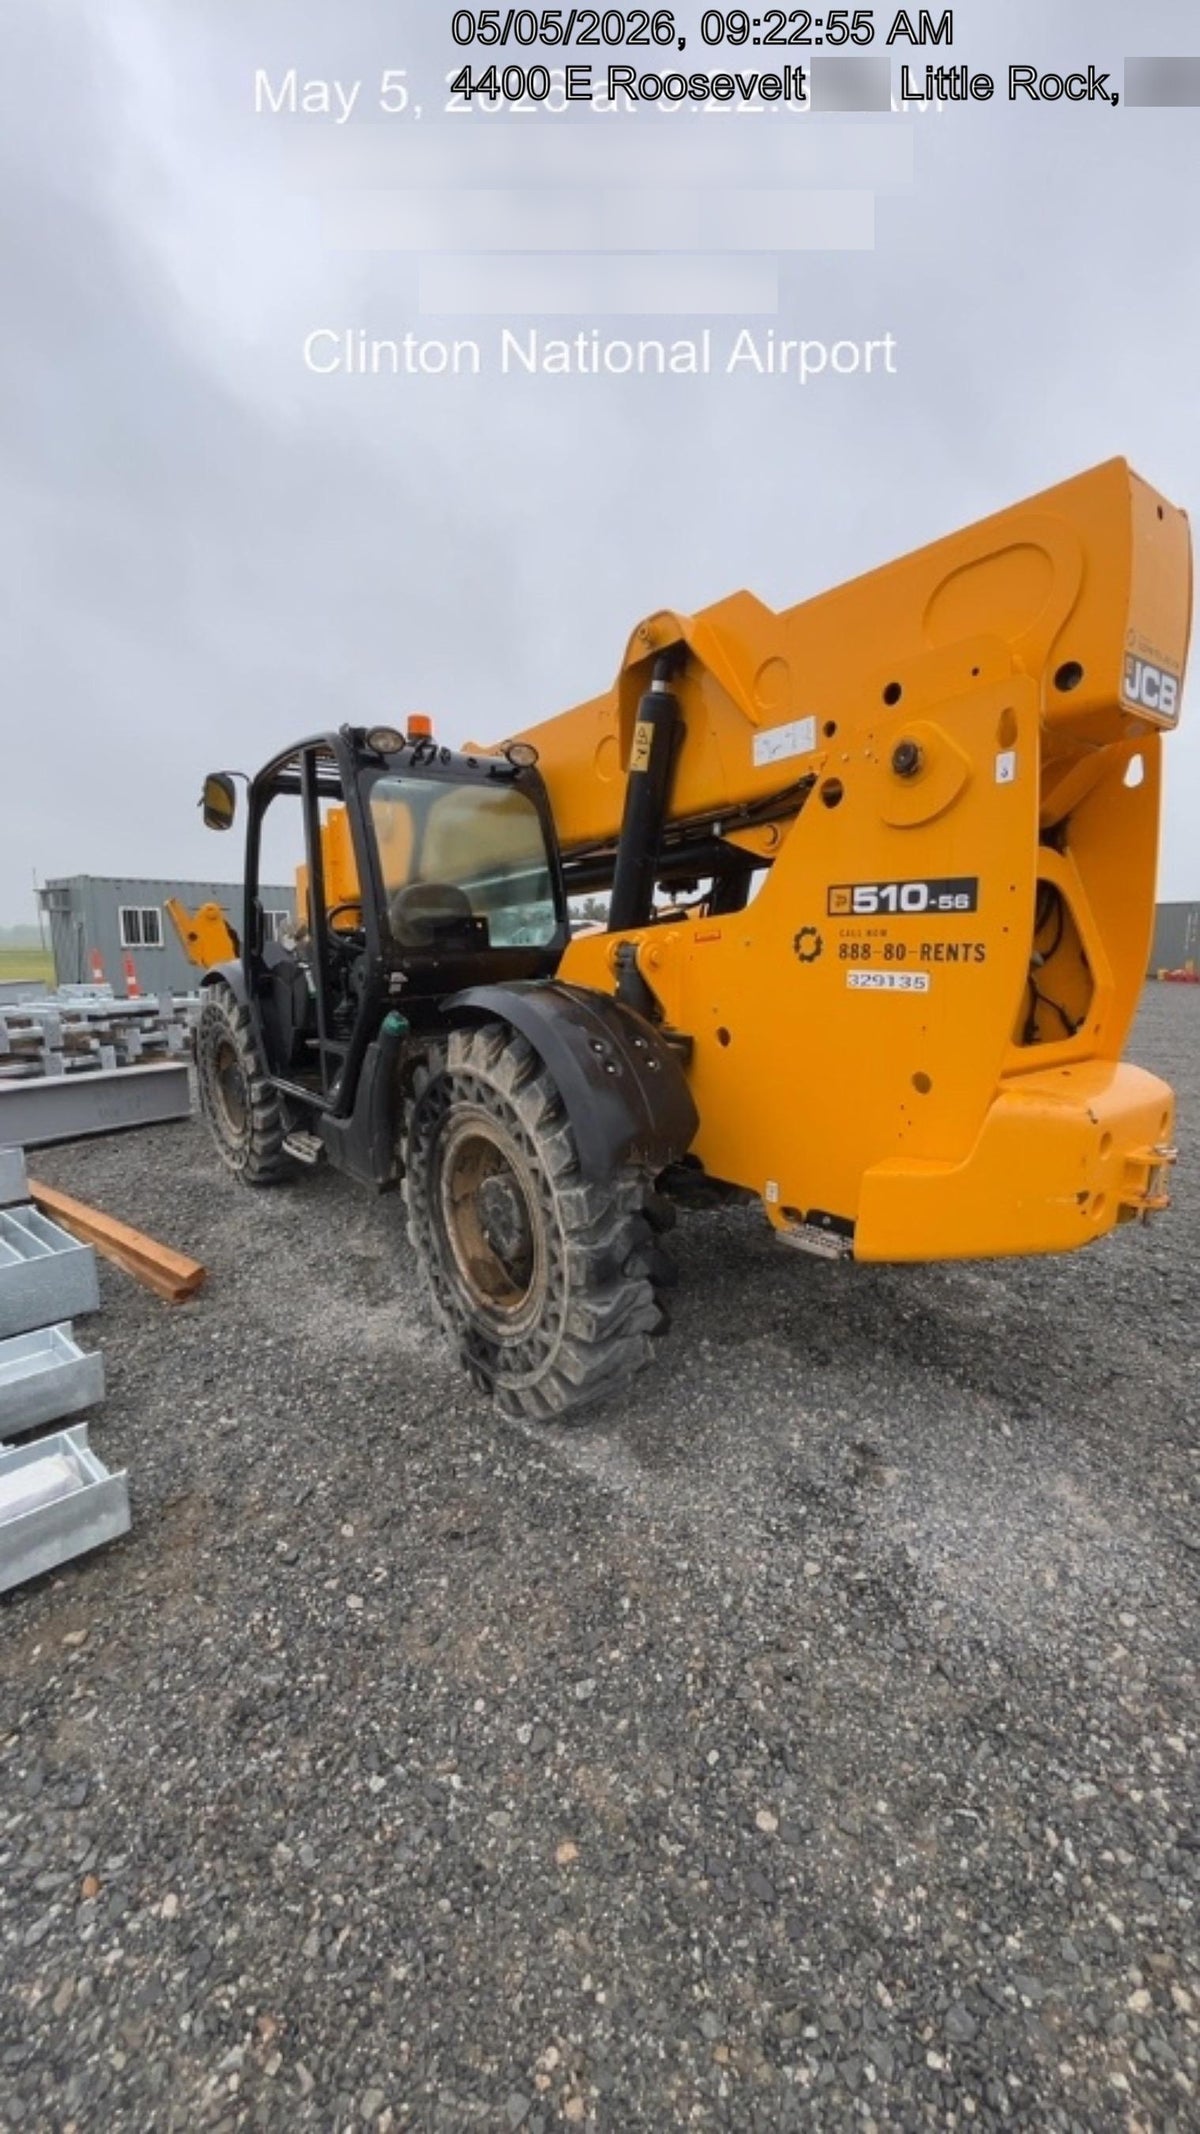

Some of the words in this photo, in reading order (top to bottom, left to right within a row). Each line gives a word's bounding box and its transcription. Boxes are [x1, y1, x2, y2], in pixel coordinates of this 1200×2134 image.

[1125, 659, 1178, 715] JCB
[852, 883, 970, 914] 510-56
[838, 942, 986, 963] 888-80-RENTS
[848, 973, 926, 990] 329135
